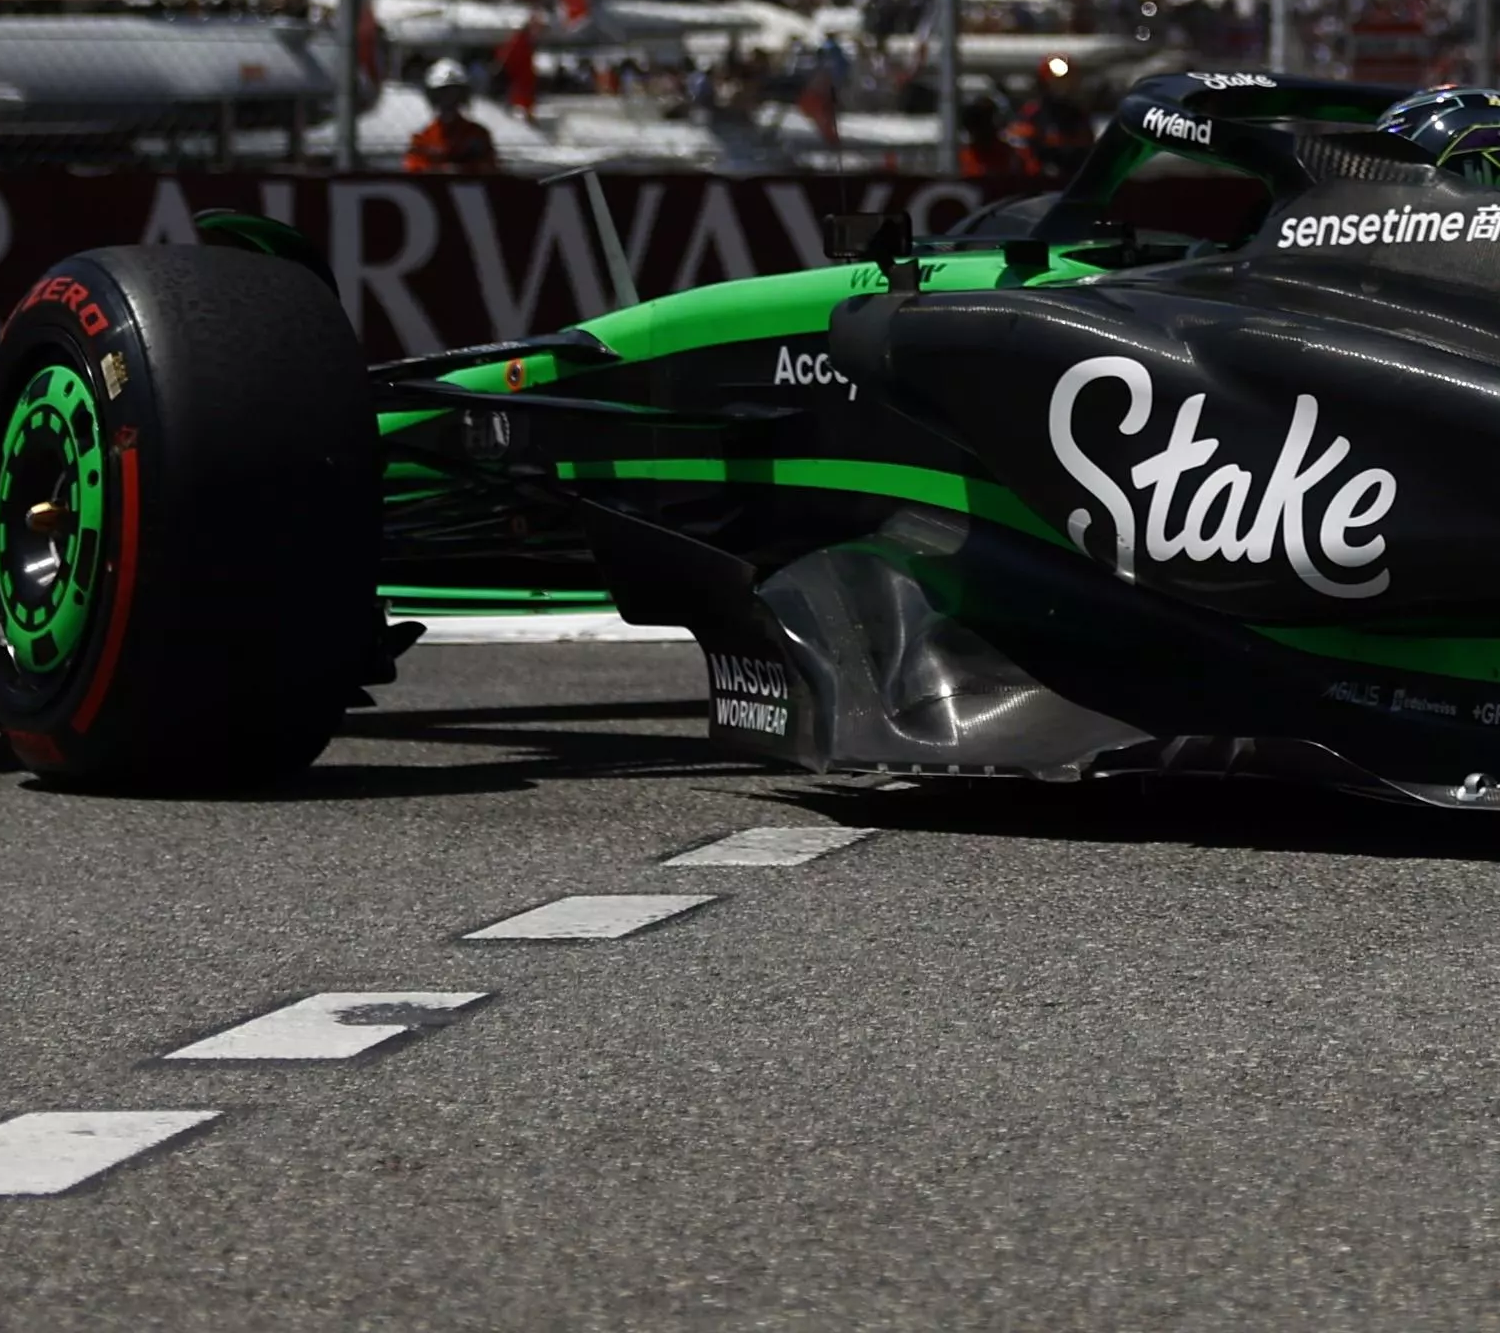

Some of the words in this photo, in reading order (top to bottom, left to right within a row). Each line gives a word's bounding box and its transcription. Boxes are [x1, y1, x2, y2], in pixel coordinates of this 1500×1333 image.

[1186, 72, 1277, 90] Stake
[1142, 106, 1213, 145] Hyland
[1277, 204, 1465, 248] sensetime
[773, 345, 858, 401] Acc
[1050, 356, 1397, 598] Stake
[710, 652, 788, 700] MASCOT
[716, 697, 788, 737] WORKWEAR
